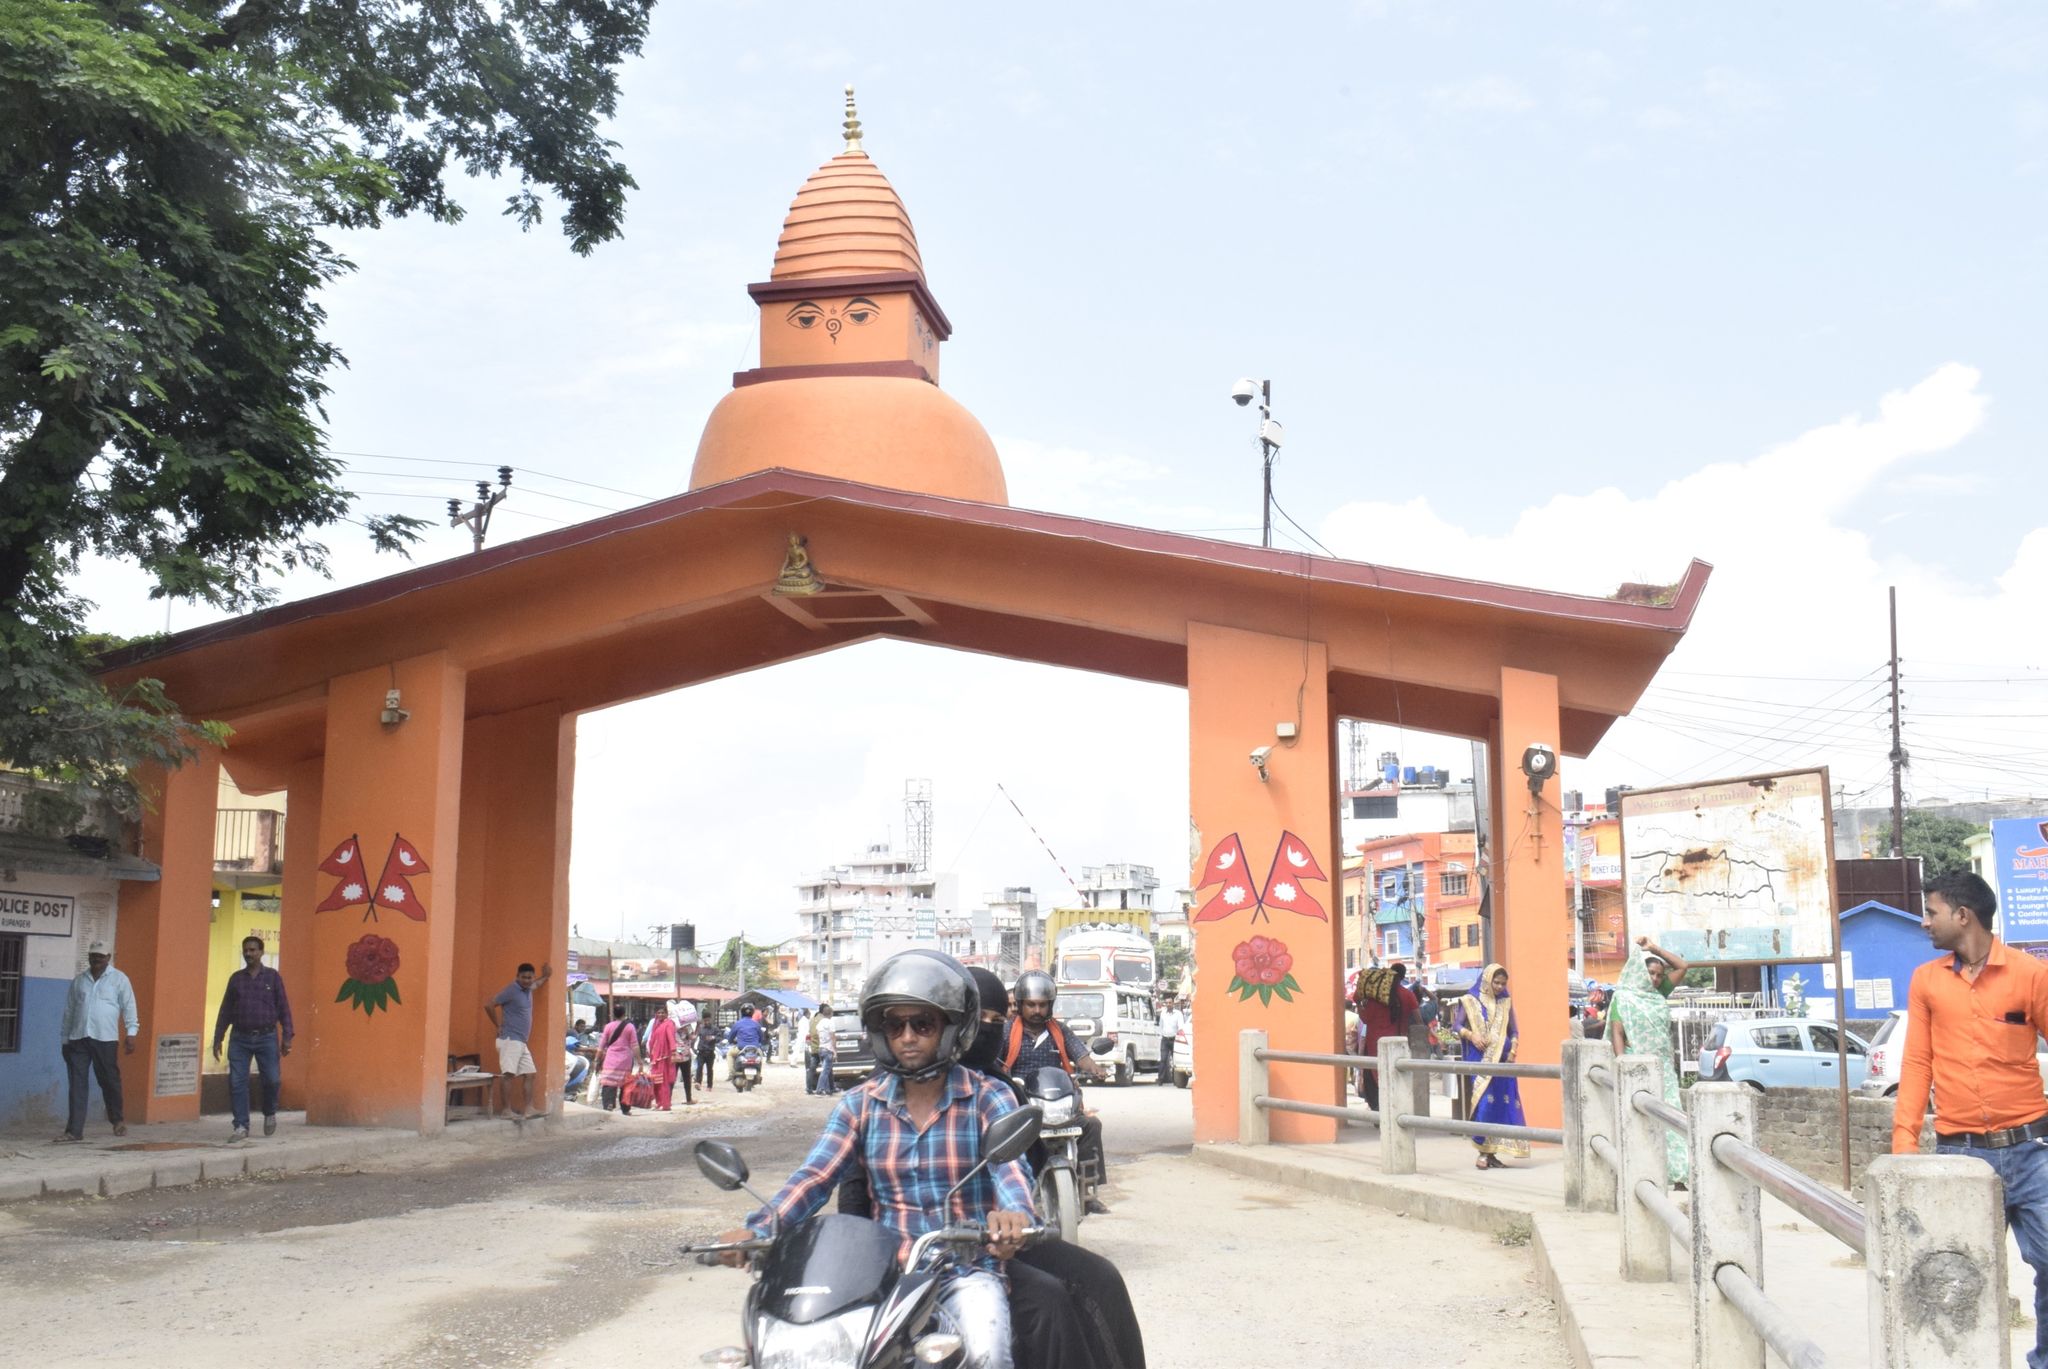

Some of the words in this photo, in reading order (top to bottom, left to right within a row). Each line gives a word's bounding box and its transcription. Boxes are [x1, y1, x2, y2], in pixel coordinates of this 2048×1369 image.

[1632, 798, 1685, 810] Welcome
[1687, 796, 1700, 805] to
[1767, 811, 1778, 819] MAP
[1591, 865, 1609, 874] MONEY
[33, 901, 68, 918] POST
